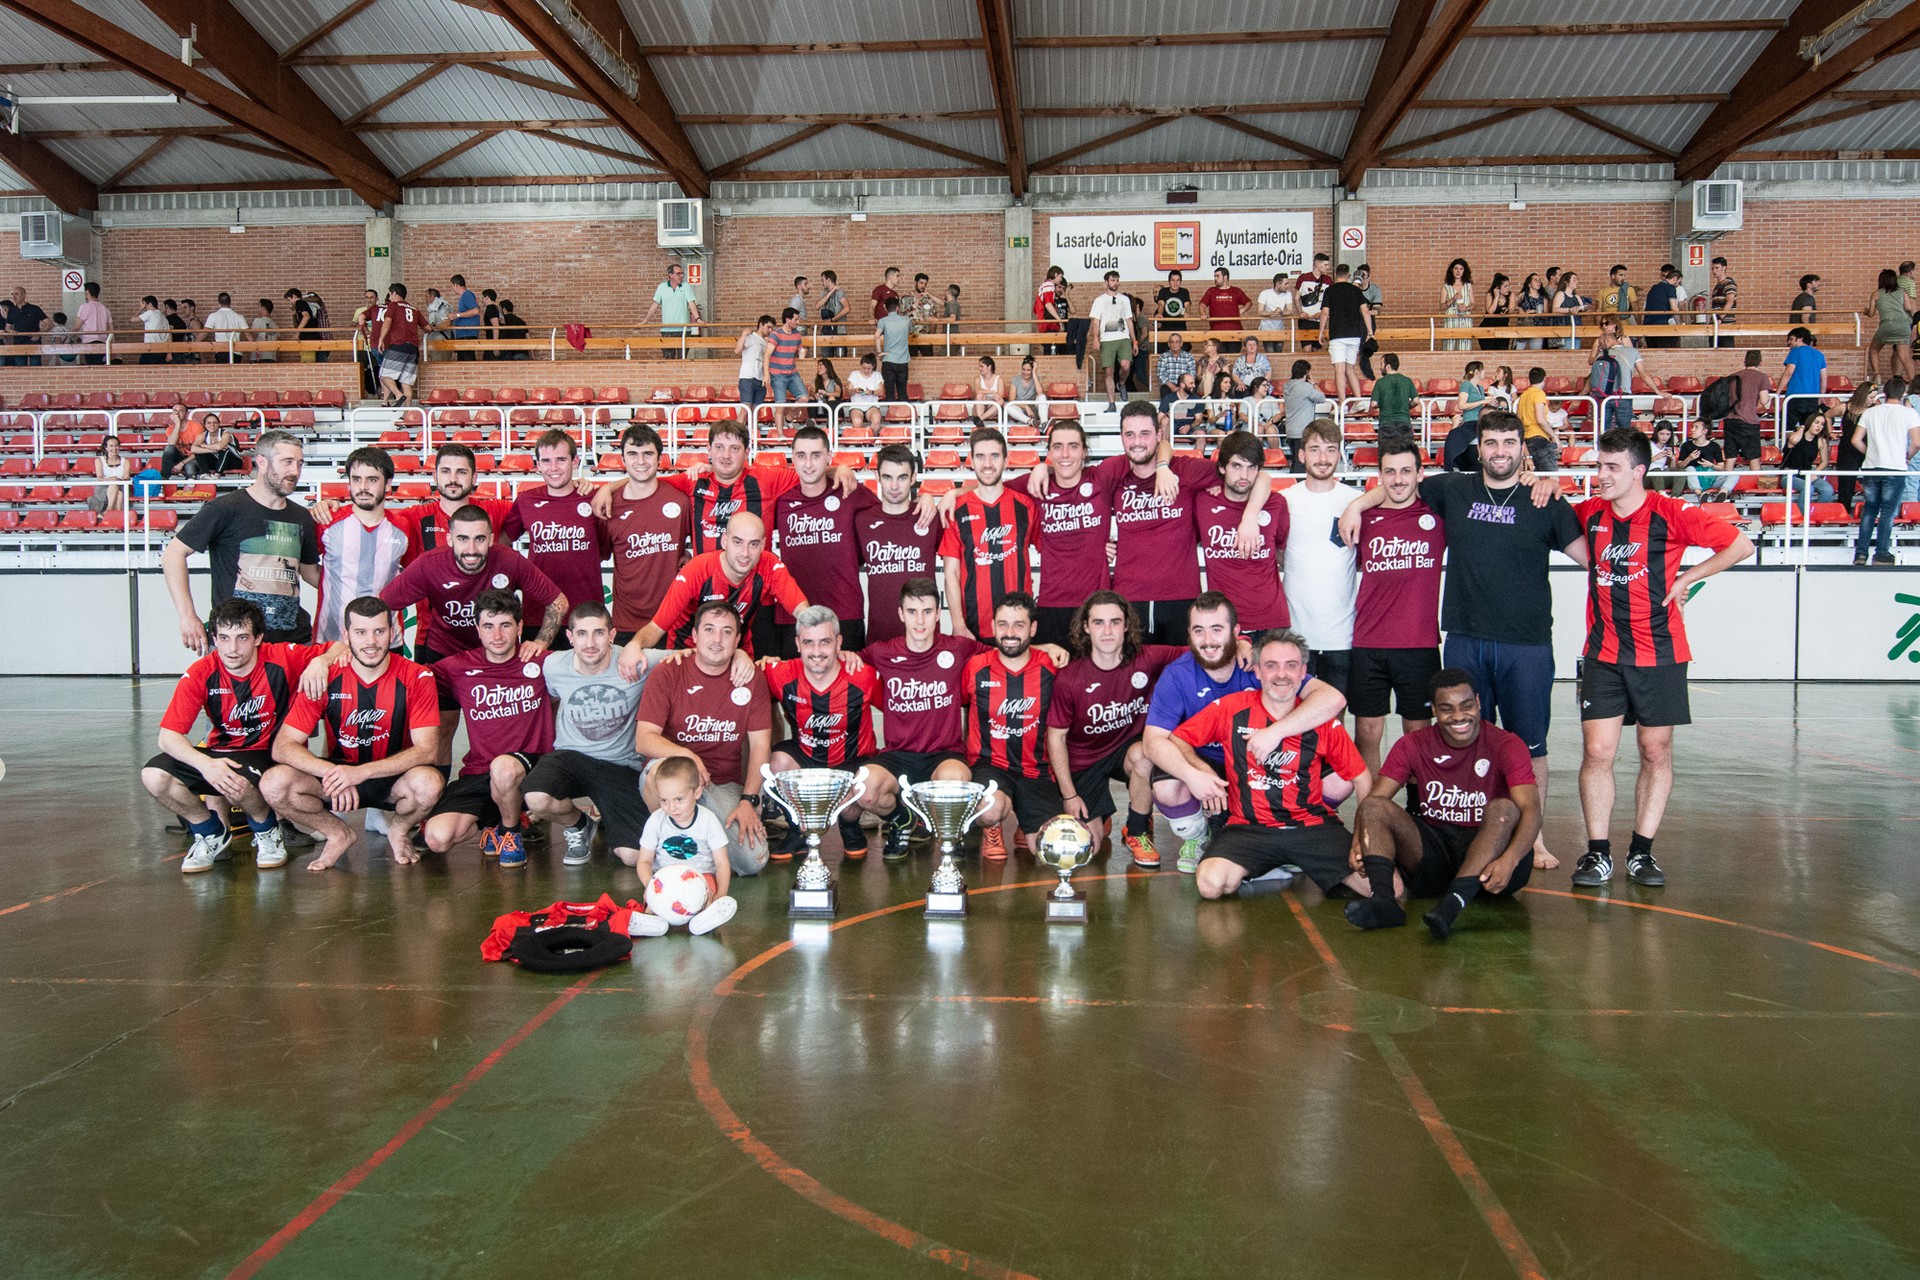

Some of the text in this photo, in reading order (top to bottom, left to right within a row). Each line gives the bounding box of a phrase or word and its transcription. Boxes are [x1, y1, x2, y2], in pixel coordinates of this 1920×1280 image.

[1056, 230, 1147, 249] Lasarte-Oriako
[1215, 227, 1298, 247] Ayuntamiento
[1084, 252, 1119, 269] Udala
[1210, 248, 1303, 267] de Lasarte-Oria
[405, 307, 414, 323] 8
[787, 513, 835, 534] Patricio
[1041, 515, 1102, 533] Cocktail Bar
[1116, 507, 1184, 523] Cocktail Bar
[530, 520, 586, 541] Patricio
[700, 519, 726, 534] Katta
[1208, 525, 1265, 547] Pato
[533, 539, 591, 554] Cocktail Bar
[627, 531, 672, 549] Patricio
[785, 531, 843, 547] Cocktail Bar
[1368, 536, 1430, 559] Patricio
[625, 542, 679, 559] Cocktail Bar
[866, 540, 921, 562] Patricio
[1205, 547, 1245, 559] Cockta
[250, 568, 273, 578] SKATE
[907, 560, 926, 572] Bar
[1365, 556, 1435, 573] Cocktail Bar
[1594, 564, 1650, 585] Kattagorri
[471, 684, 535, 707] Patricio
[887, 677, 948, 700] Patricio
[470, 697, 542, 721] Cocktail Bar
[888, 694, 954, 713] Cocktail Bar
[684, 714, 737, 733] Patricio
[988, 717, 1040, 737] Kattagorri
[1083, 703, 1150, 735] Cocktail ar
[676, 731, 740, 743] Cocktail Bar
[798, 729, 849, 748] attagorri
[1236, 725, 1259, 734] JOM
[1426, 780, 1487, 808] Patricio
[1420, 801, 1470, 822] Cocktail
